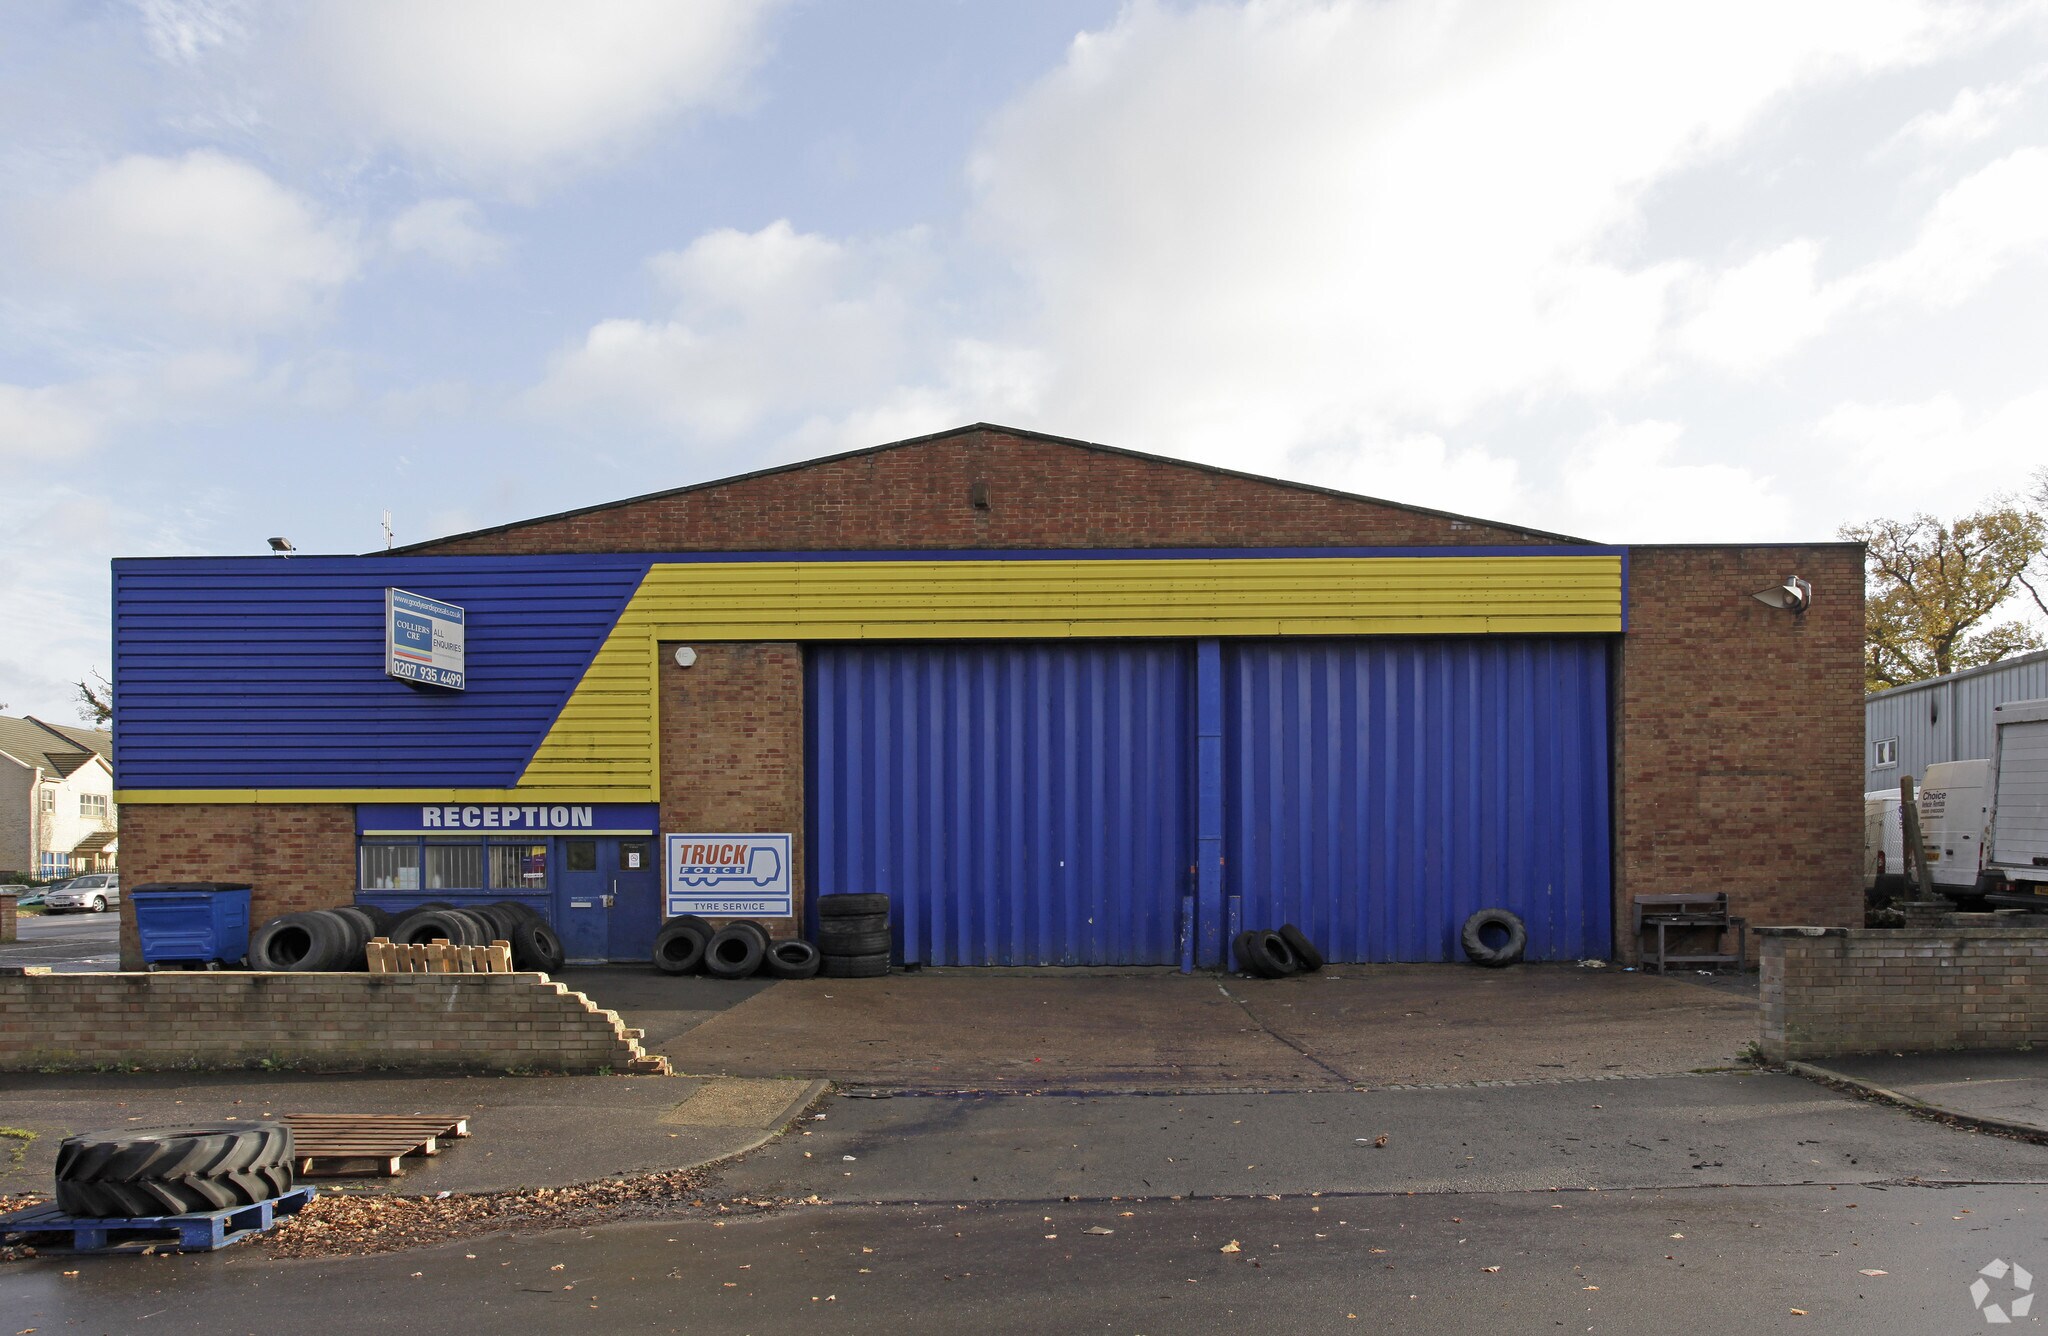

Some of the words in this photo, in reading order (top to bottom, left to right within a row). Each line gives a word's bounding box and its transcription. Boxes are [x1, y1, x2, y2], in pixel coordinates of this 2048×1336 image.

[396, 620, 430, 635] COLLIERS
[433, 629, 444, 638] ALL
[406, 631, 420, 641] CRE
[433, 639, 462, 653] ENQUIRIES
[394, 660, 417, 677] 0207
[420, 666, 438, 681] 935
[440, 670, 462, 687] 4499
[1923, 790, 1947, 801] Choice
[422, 806, 593, 828] RECEPTION
[680, 844, 748, 865] TRUCK
[694, 902, 720, 911] TYRE
[722, 902, 765, 911] SERVICE
